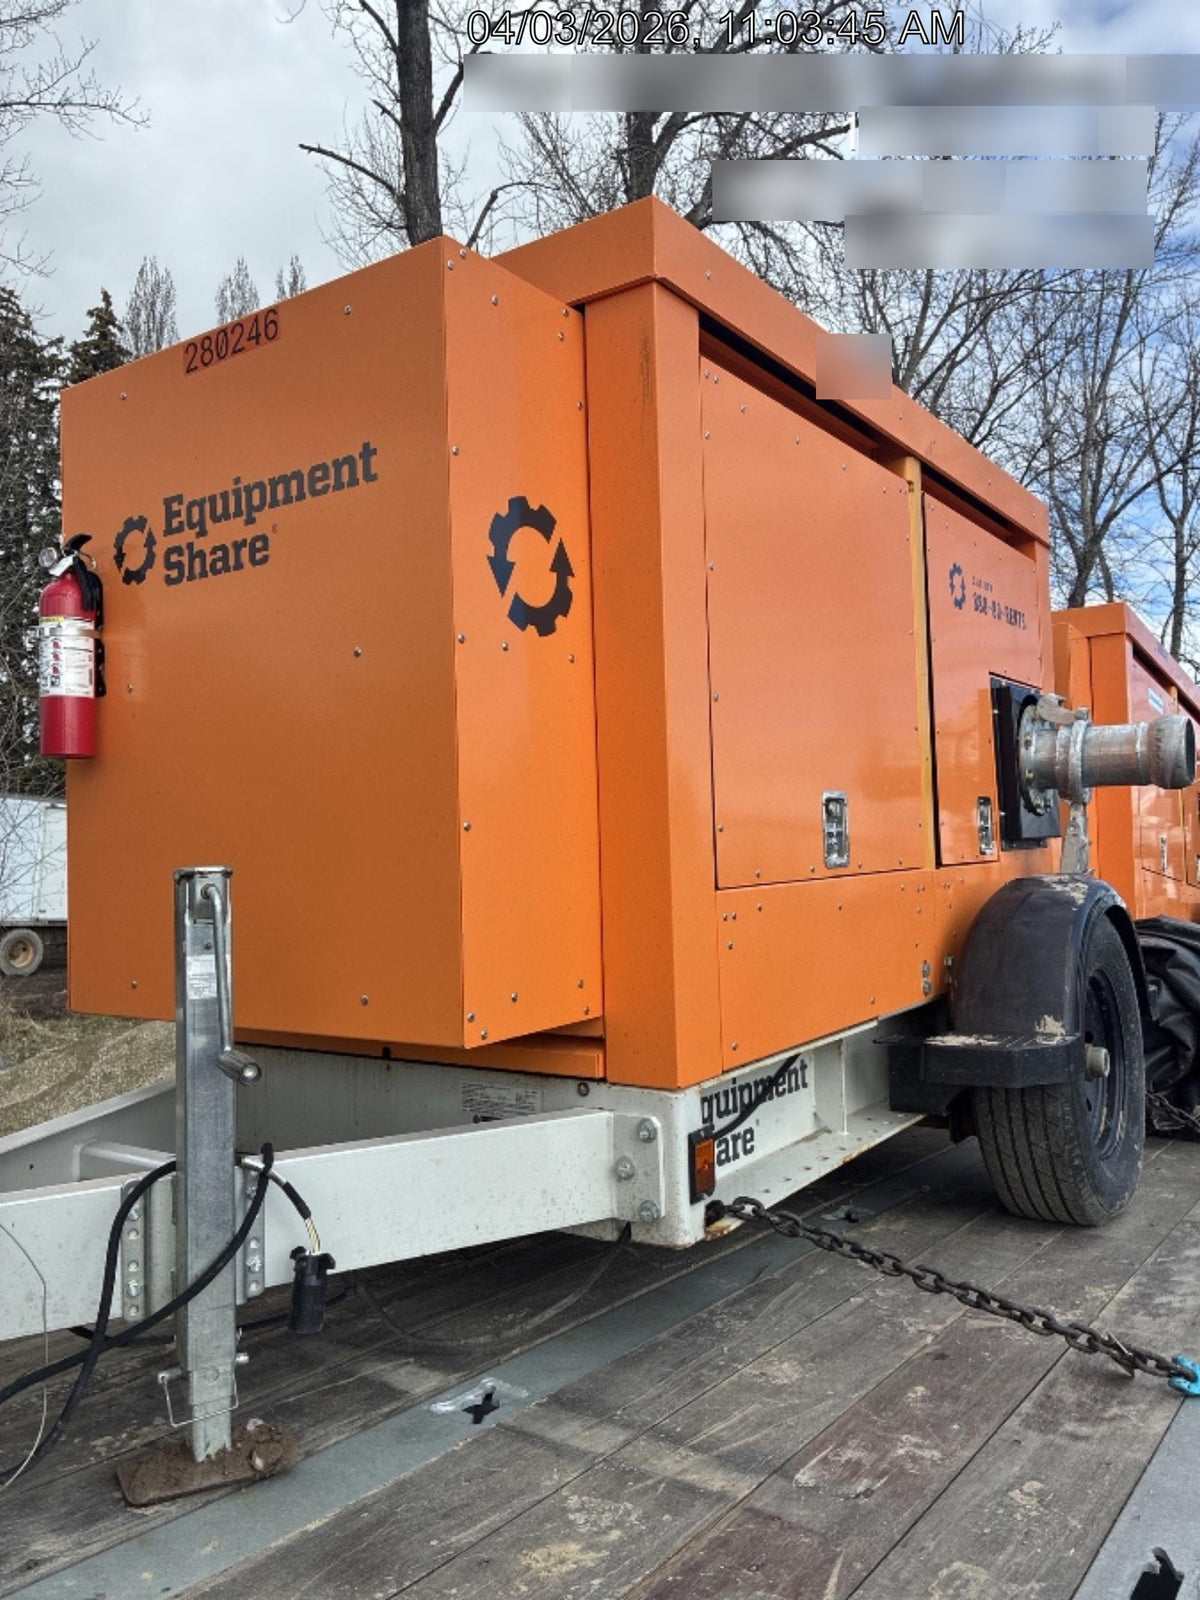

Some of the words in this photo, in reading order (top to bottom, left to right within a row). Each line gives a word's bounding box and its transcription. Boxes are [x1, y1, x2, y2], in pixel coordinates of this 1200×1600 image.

[185, 309, 279, 374] 280246
[163, 441, 378, 538] Equipment
[164, 533, 269, 586] Share
[702, 1059, 808, 1125] quipment
[716, 1127, 755, 1167] are
